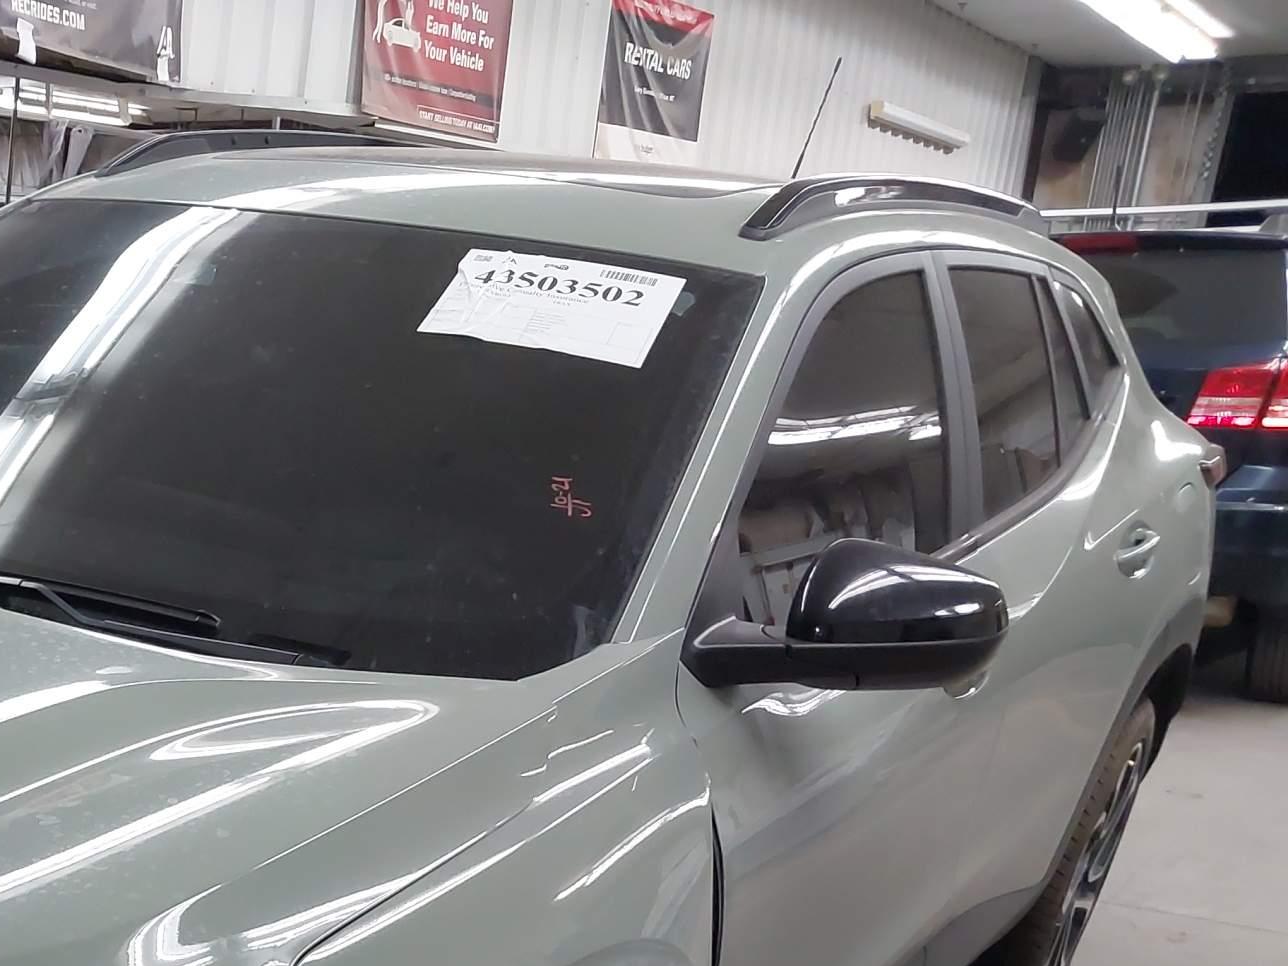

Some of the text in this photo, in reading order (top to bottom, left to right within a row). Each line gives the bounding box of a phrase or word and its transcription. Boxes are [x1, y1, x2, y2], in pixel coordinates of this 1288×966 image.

[11, 0, 85, 30] RECRIDES.COM
[446, 0, 469, 22] Help
[471, 2, 489, 24] You
[426, 15, 494, 50] Earn More For
[424, 40, 484, 71] Your Vehicle
[624, 42, 692, 79] RENTAL CARS
[474, 269, 644, 307] 43503502
